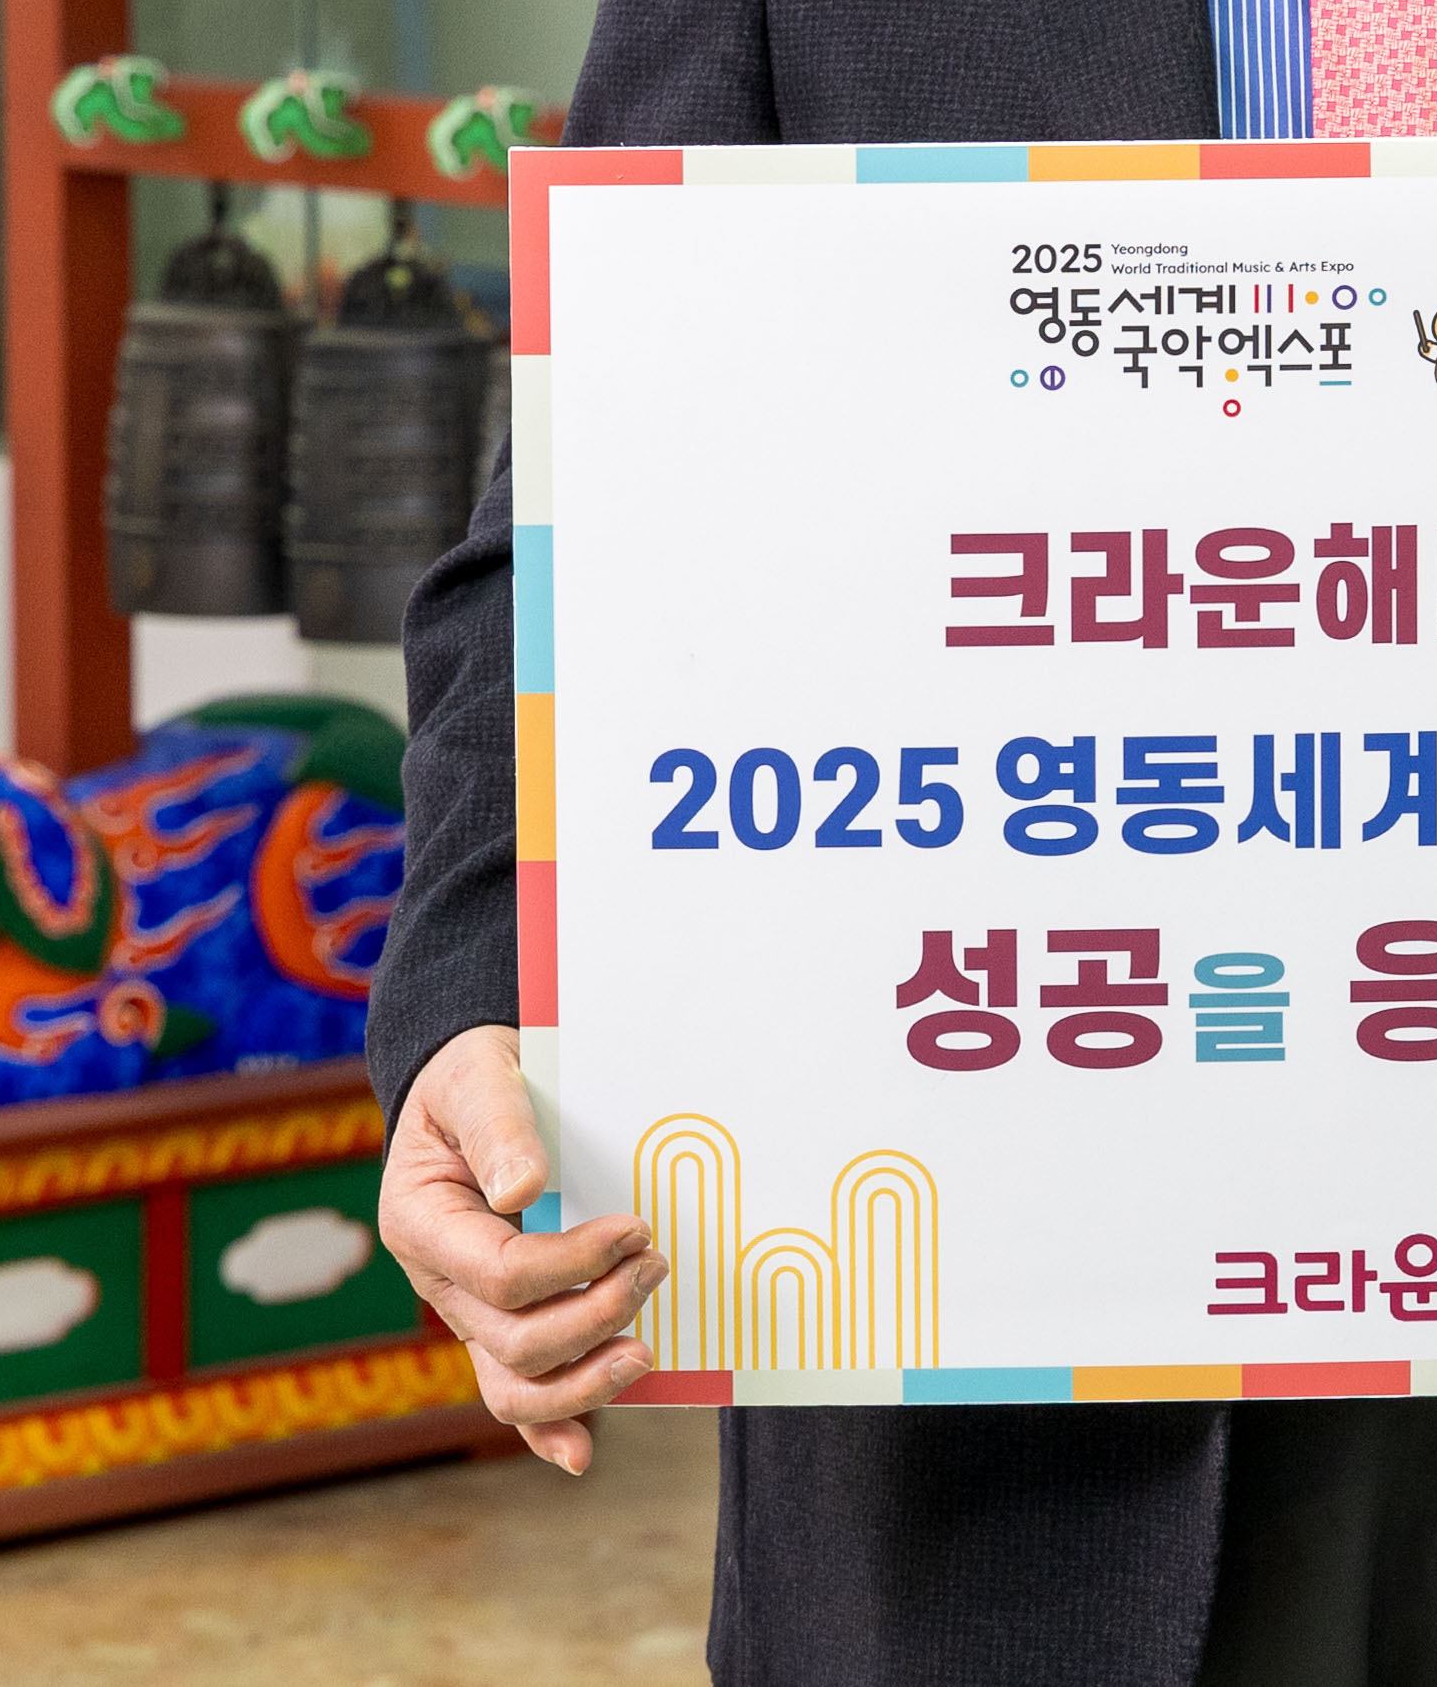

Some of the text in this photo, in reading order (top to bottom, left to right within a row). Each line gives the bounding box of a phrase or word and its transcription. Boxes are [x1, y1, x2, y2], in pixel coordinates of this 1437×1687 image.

[1011, 243, 1103, 274] 2025
[1110, 242, 1189, 258] Yeongdong
[1110, 260, 1355, 275] World Traditional Music & Arts Expo
[1009, 284, 1237, 358] 영동세계
[1113, 322, 1353, 389] 국악엑스포
[648, 745, 966, 852] 2025
[894, 926, 1292, 1073] 성공을
